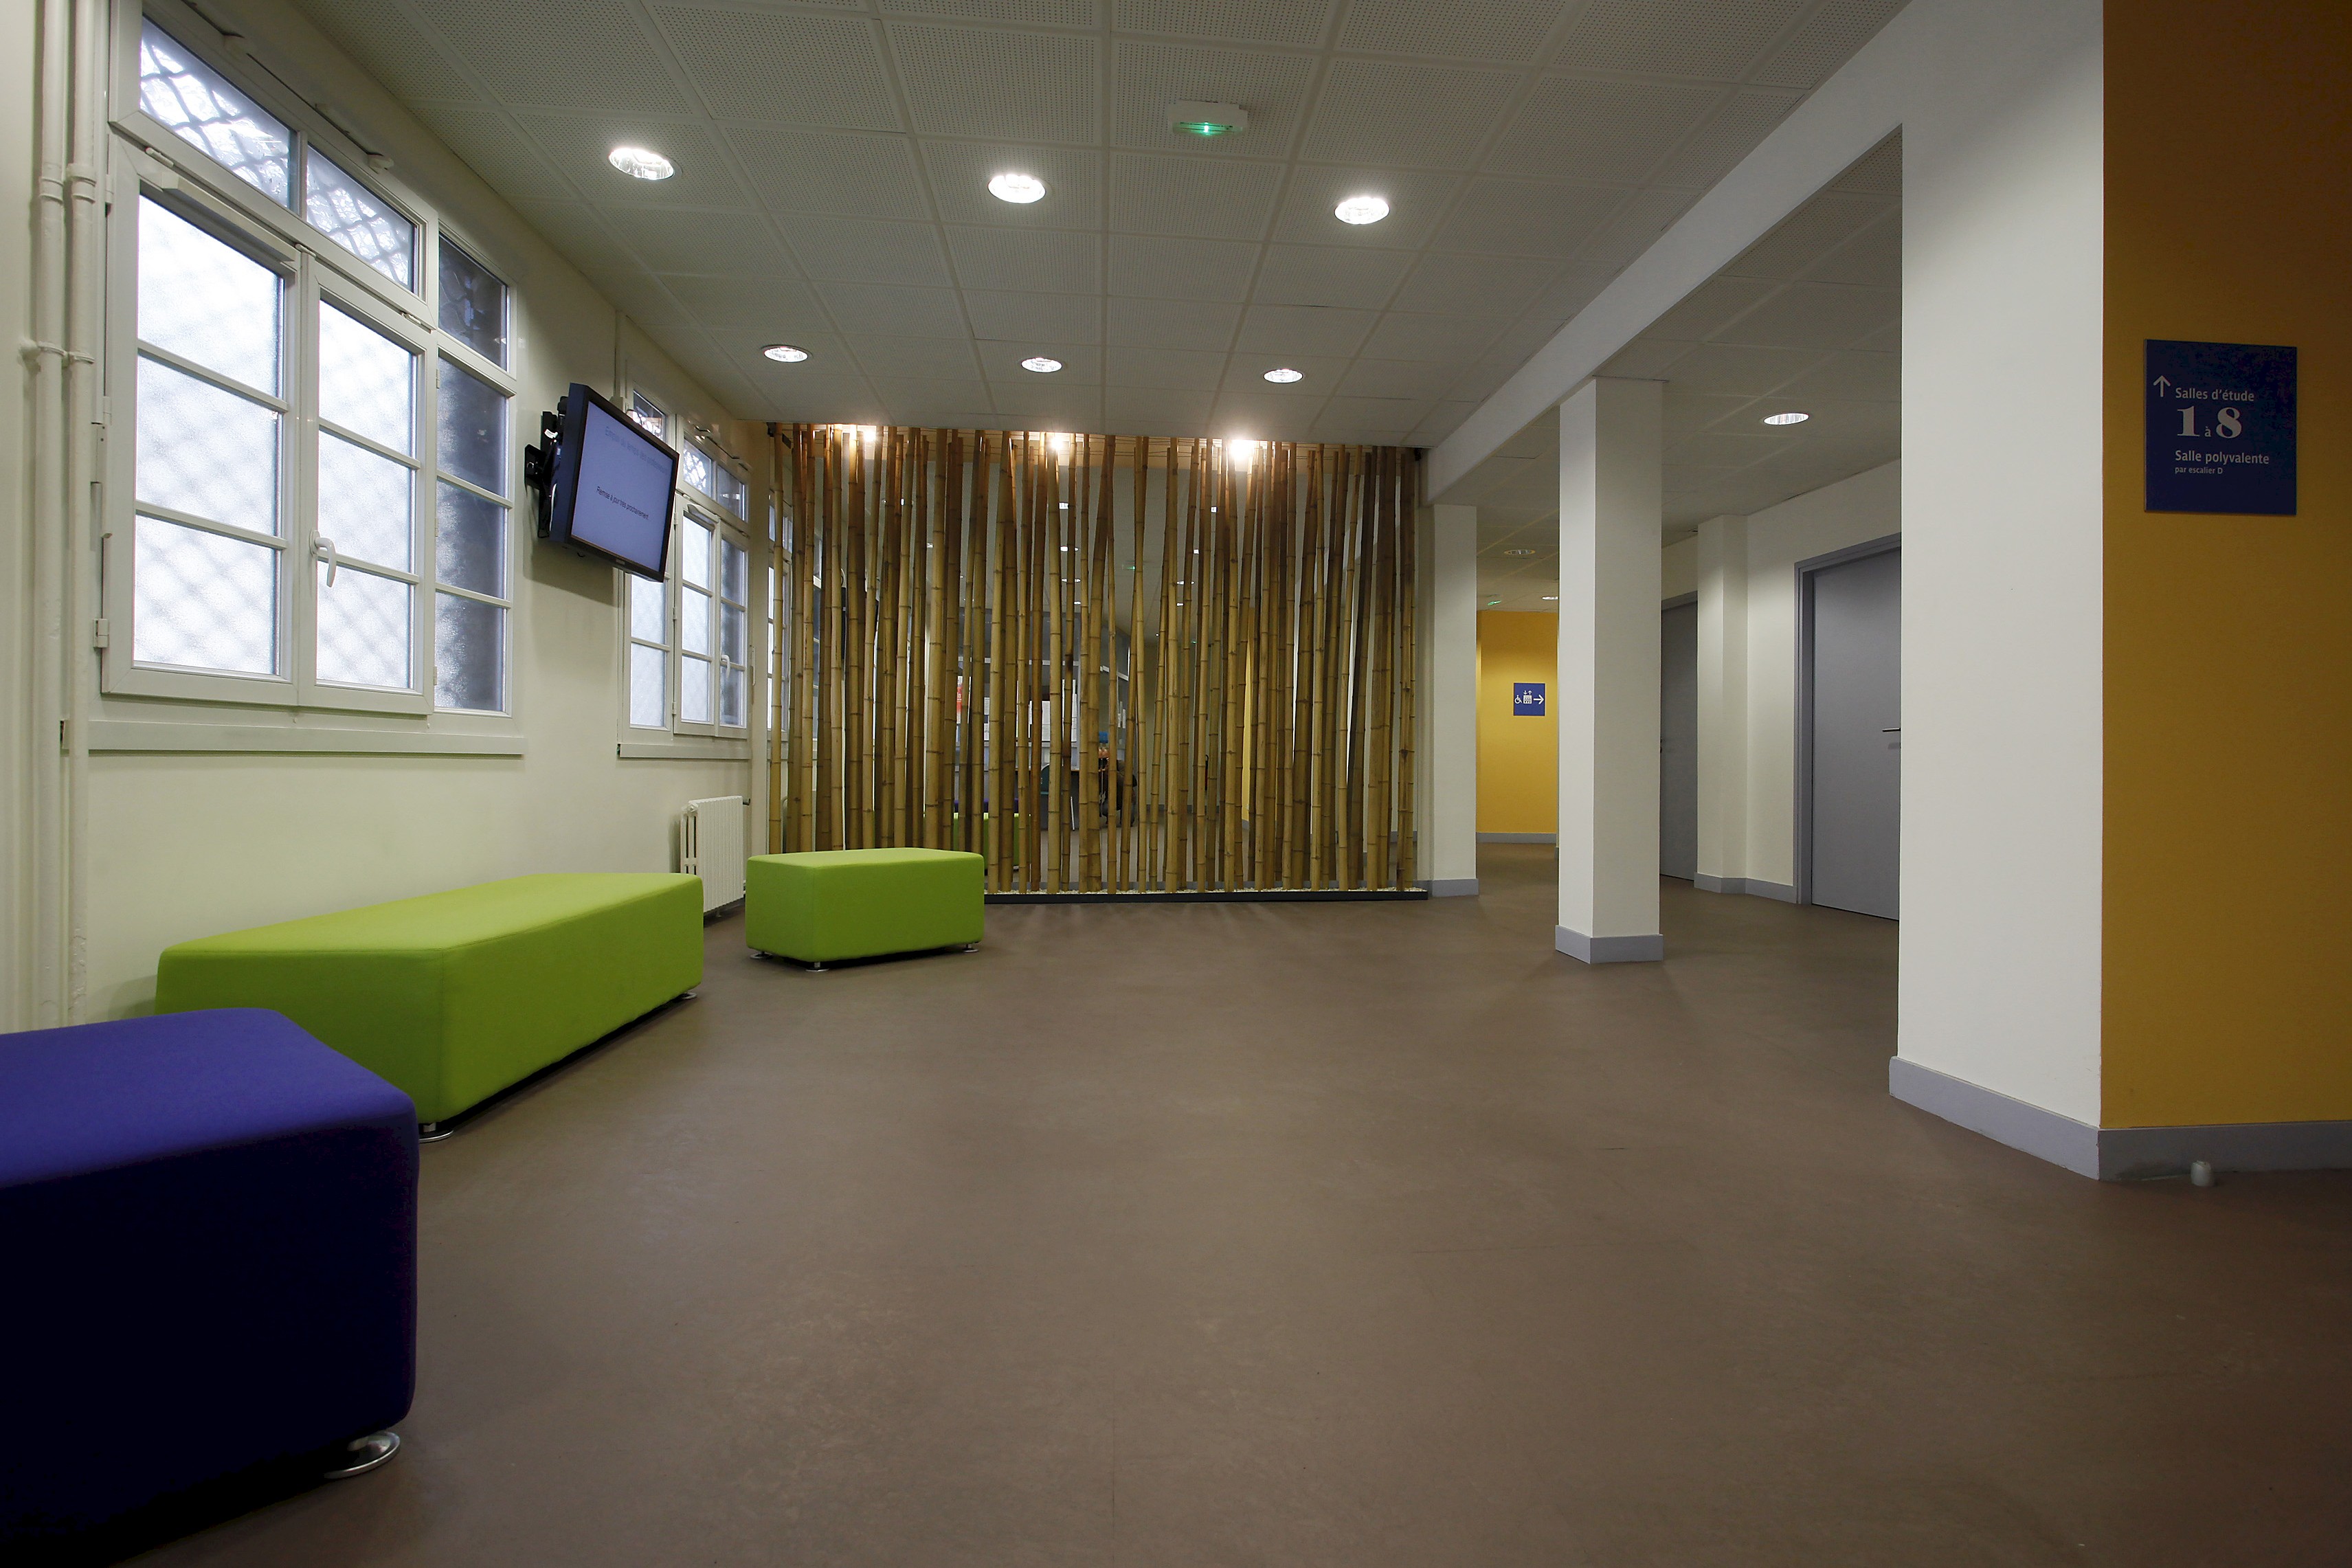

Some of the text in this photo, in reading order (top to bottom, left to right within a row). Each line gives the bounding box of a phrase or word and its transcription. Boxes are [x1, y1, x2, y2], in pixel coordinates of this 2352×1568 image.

[2175, 388, 2254, 402] Salles d’étude
[2177, 405, 2242, 438] 1 à 8
[2175, 450, 2270, 464] Salle polyvalente
